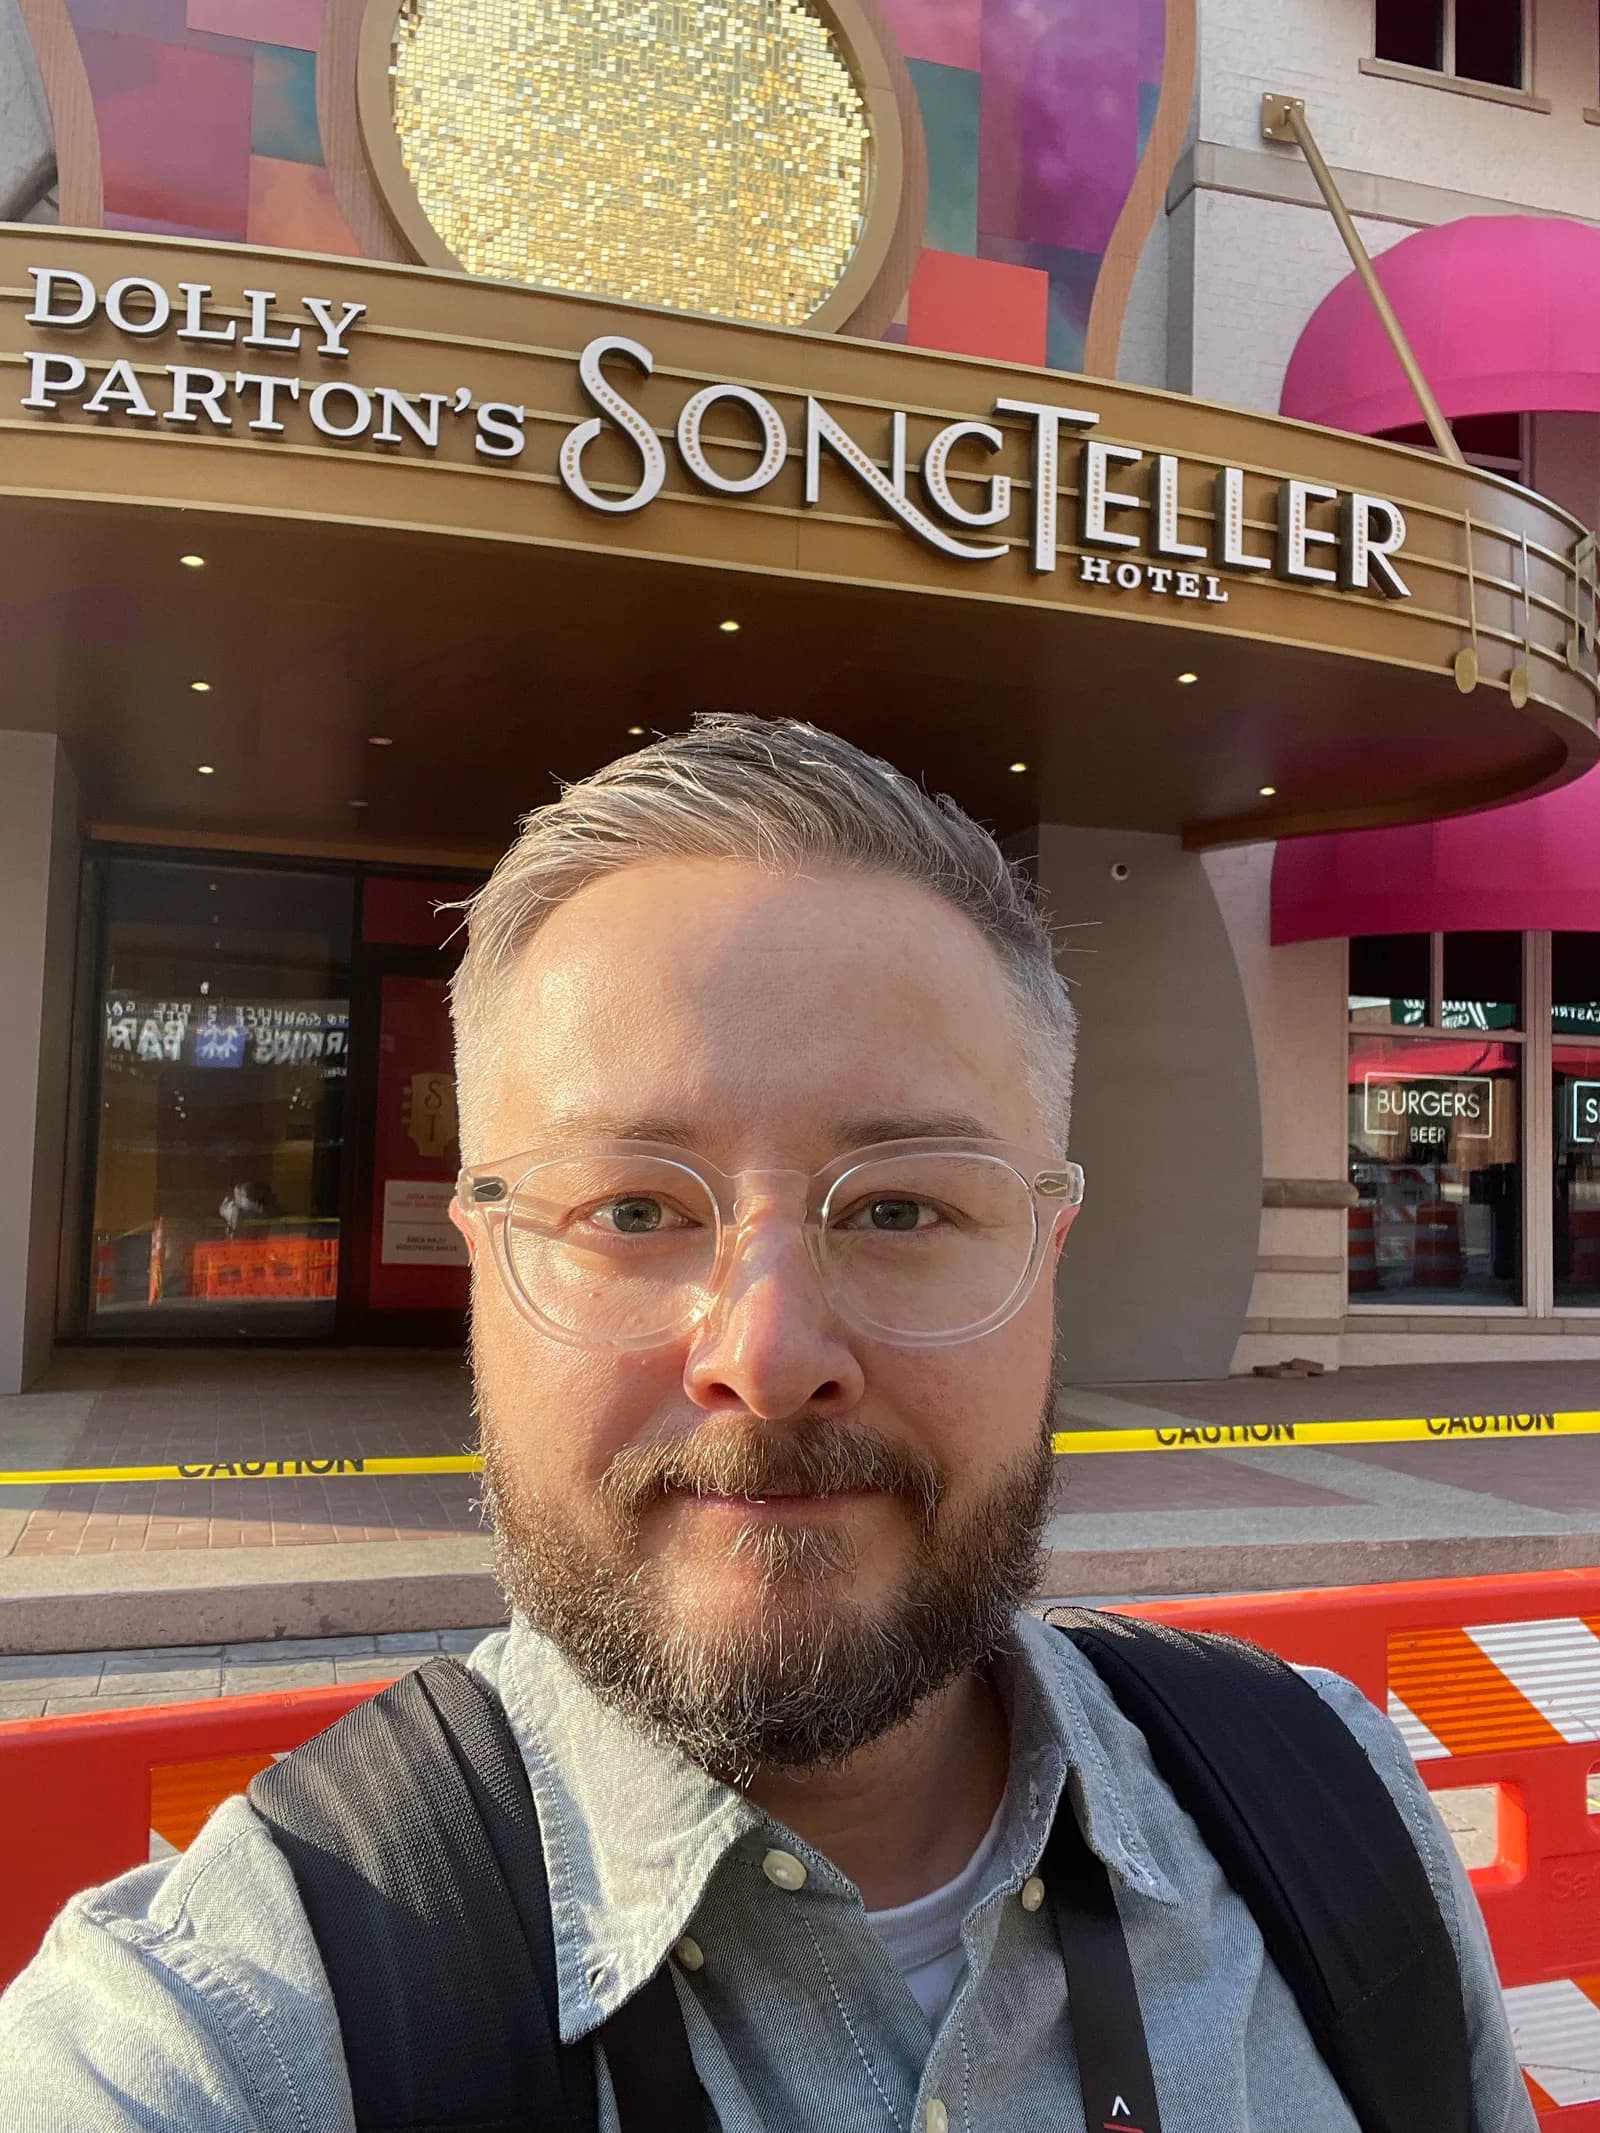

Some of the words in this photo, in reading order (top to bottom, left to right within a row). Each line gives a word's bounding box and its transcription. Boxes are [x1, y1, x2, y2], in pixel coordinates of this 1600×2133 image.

[25, 267, 366, 358] DOLLY
[21, 352, 526, 457] PARTON'S
[559, 336, 1411, 598] SONGTELLER
[1080, 556, 1229, 603] HOTEL
[1377, 1090, 1481, 1119] BURGERS
[1586, 1098, 1600, 1123] S
[1410, 1126, 1446, 1144] BEER
[1156, 1423, 1295, 1446] CAUTION
[1425, 1414, 1555, 1436] CAUTION
[177, 1458, 365, 1478] CAUTION
